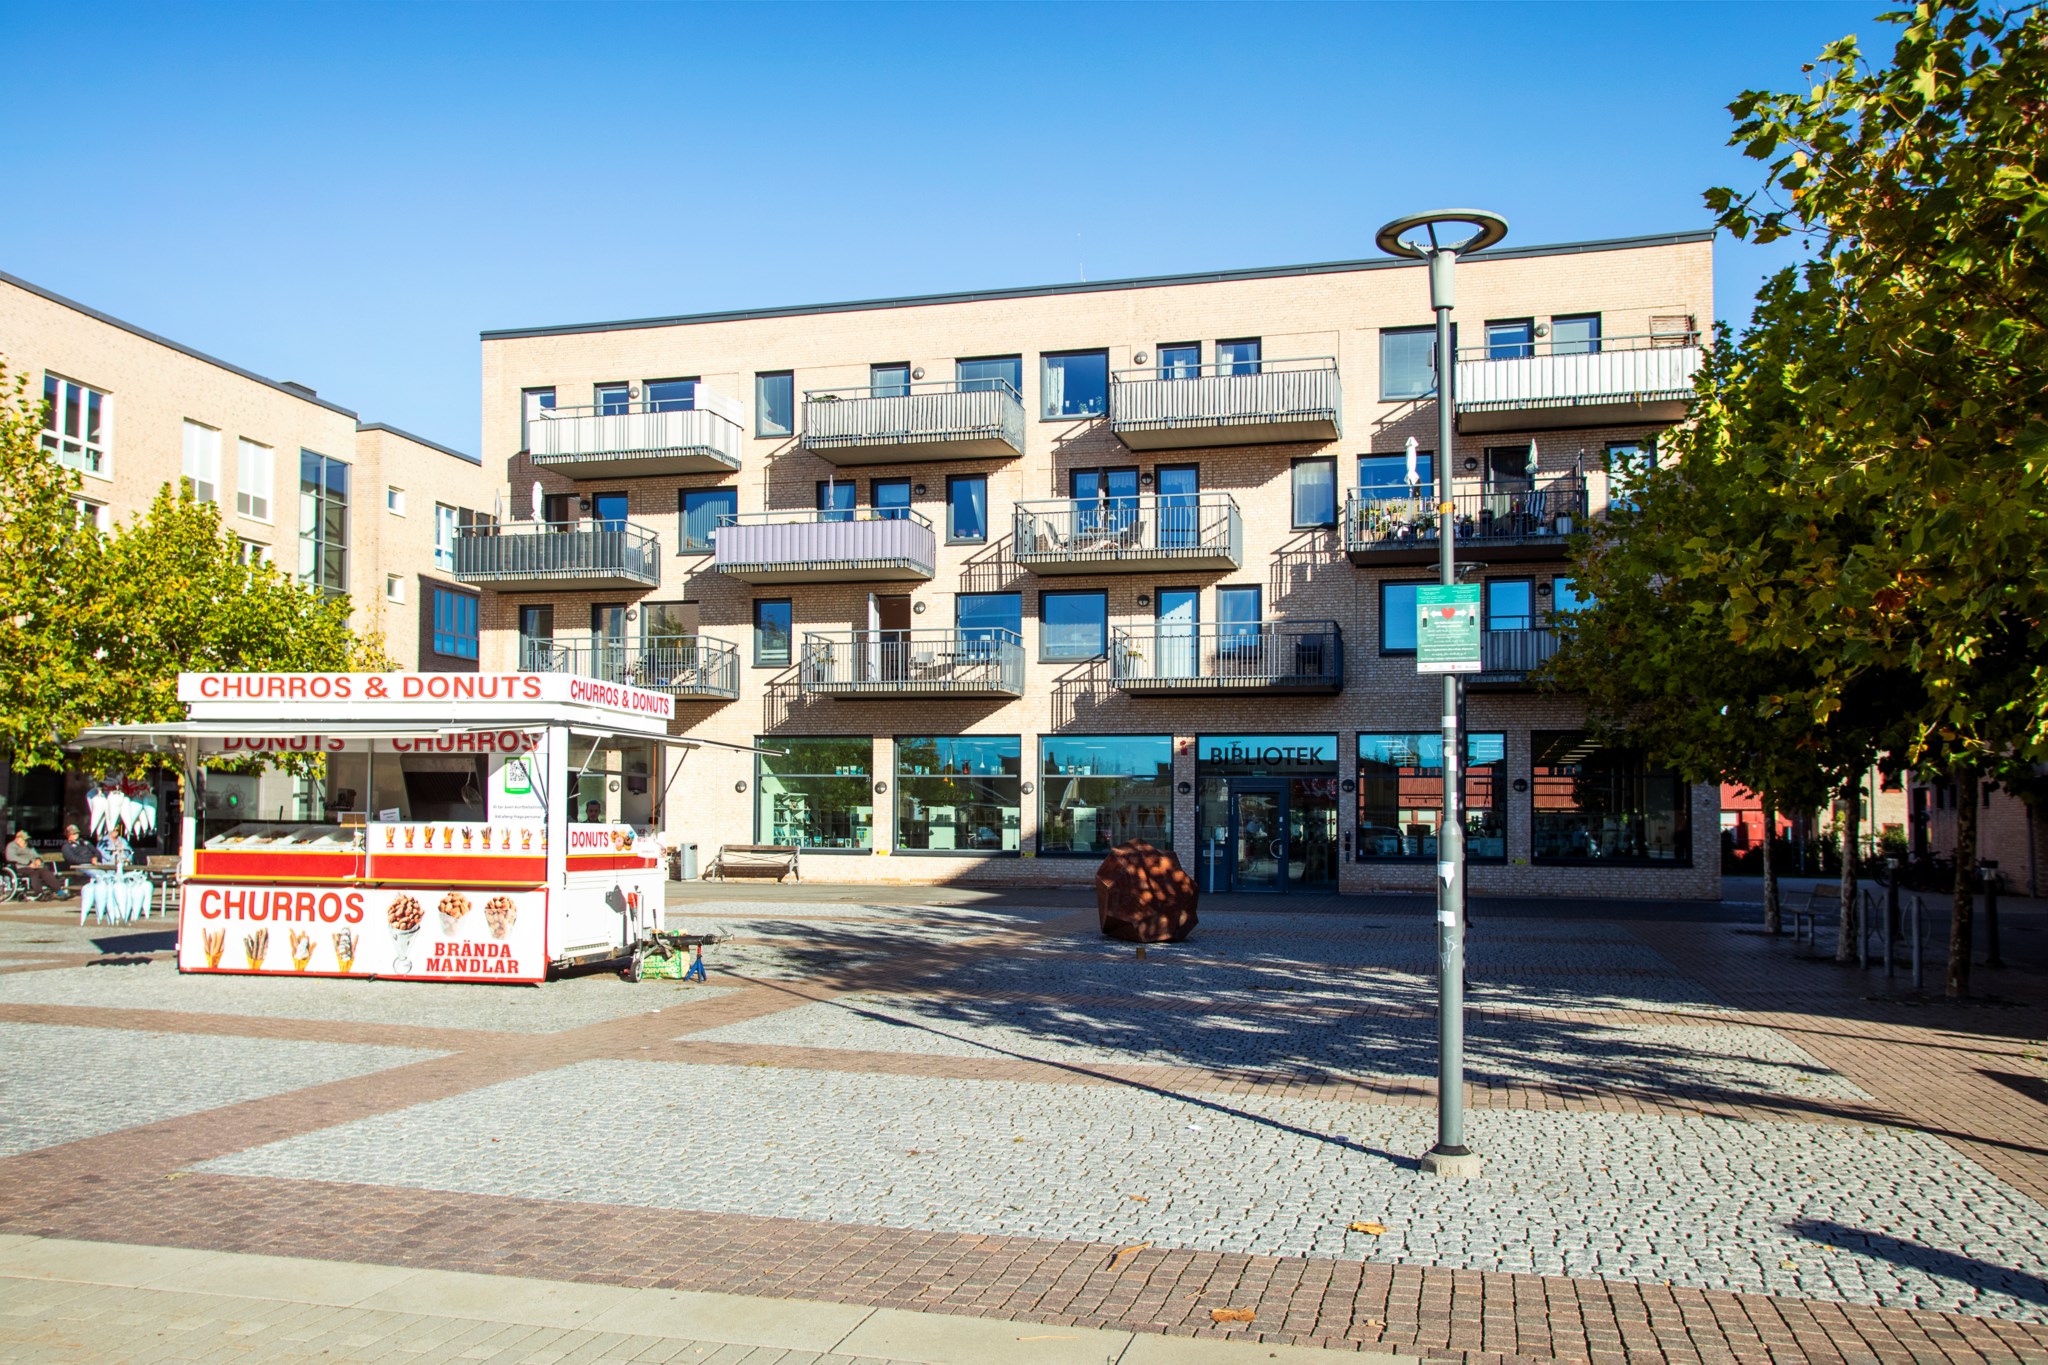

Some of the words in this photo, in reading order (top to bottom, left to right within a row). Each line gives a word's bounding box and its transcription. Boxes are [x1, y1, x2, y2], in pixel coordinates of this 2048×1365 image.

[200, 676, 352, 698] CHURROS
[364, 676, 389, 698] &
[403, 676, 542, 699] DONUTS
[570, 679, 619, 706] CHURROS
[622, 690, 629, 708] &
[632, 692, 670, 715] DONUTS
[392, 730, 542, 752] CHURROS
[1210, 746, 1324, 766] BIBLIOTEK
[571, 831, 609, 847] DONUTS
[200, 889, 365, 923] CHURROS
[434, 939, 513, 958] BRÄNDA
[426, 959, 519, 974] MANDLAR
